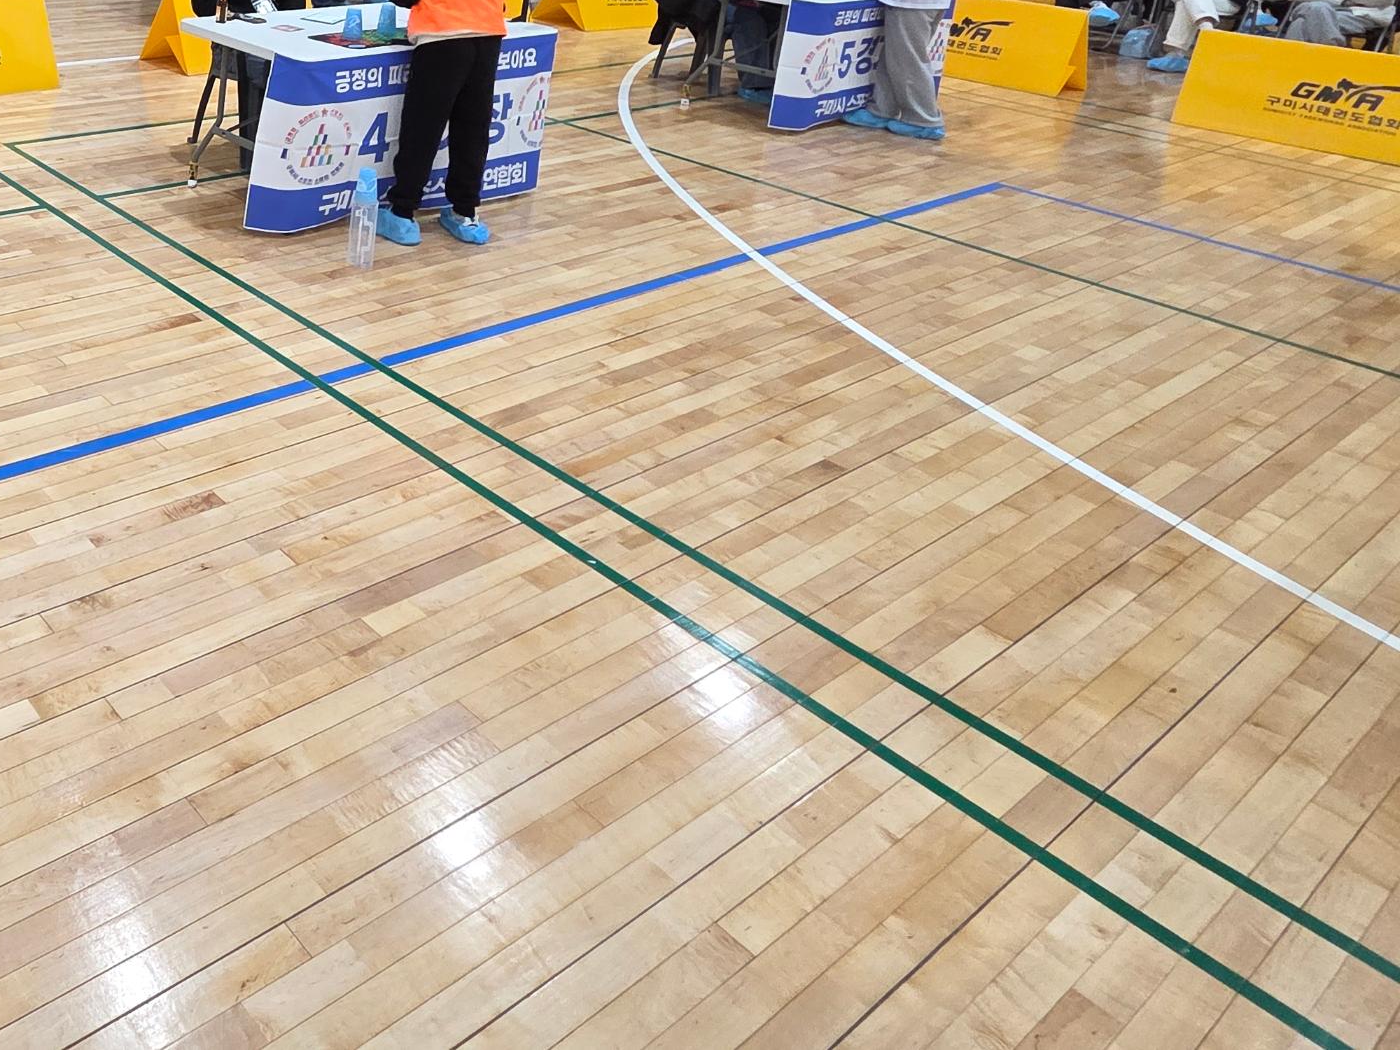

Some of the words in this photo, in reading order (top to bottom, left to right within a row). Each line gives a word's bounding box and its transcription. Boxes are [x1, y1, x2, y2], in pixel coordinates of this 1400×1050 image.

[497, 48, 537, 70] 보아요
[335, 67, 382, 93] 긍정의
[1266, 95, 1400, 130] 구미시태권도협회
[358, 112, 390, 163] 4
[483, 161, 527, 191] 연합회
